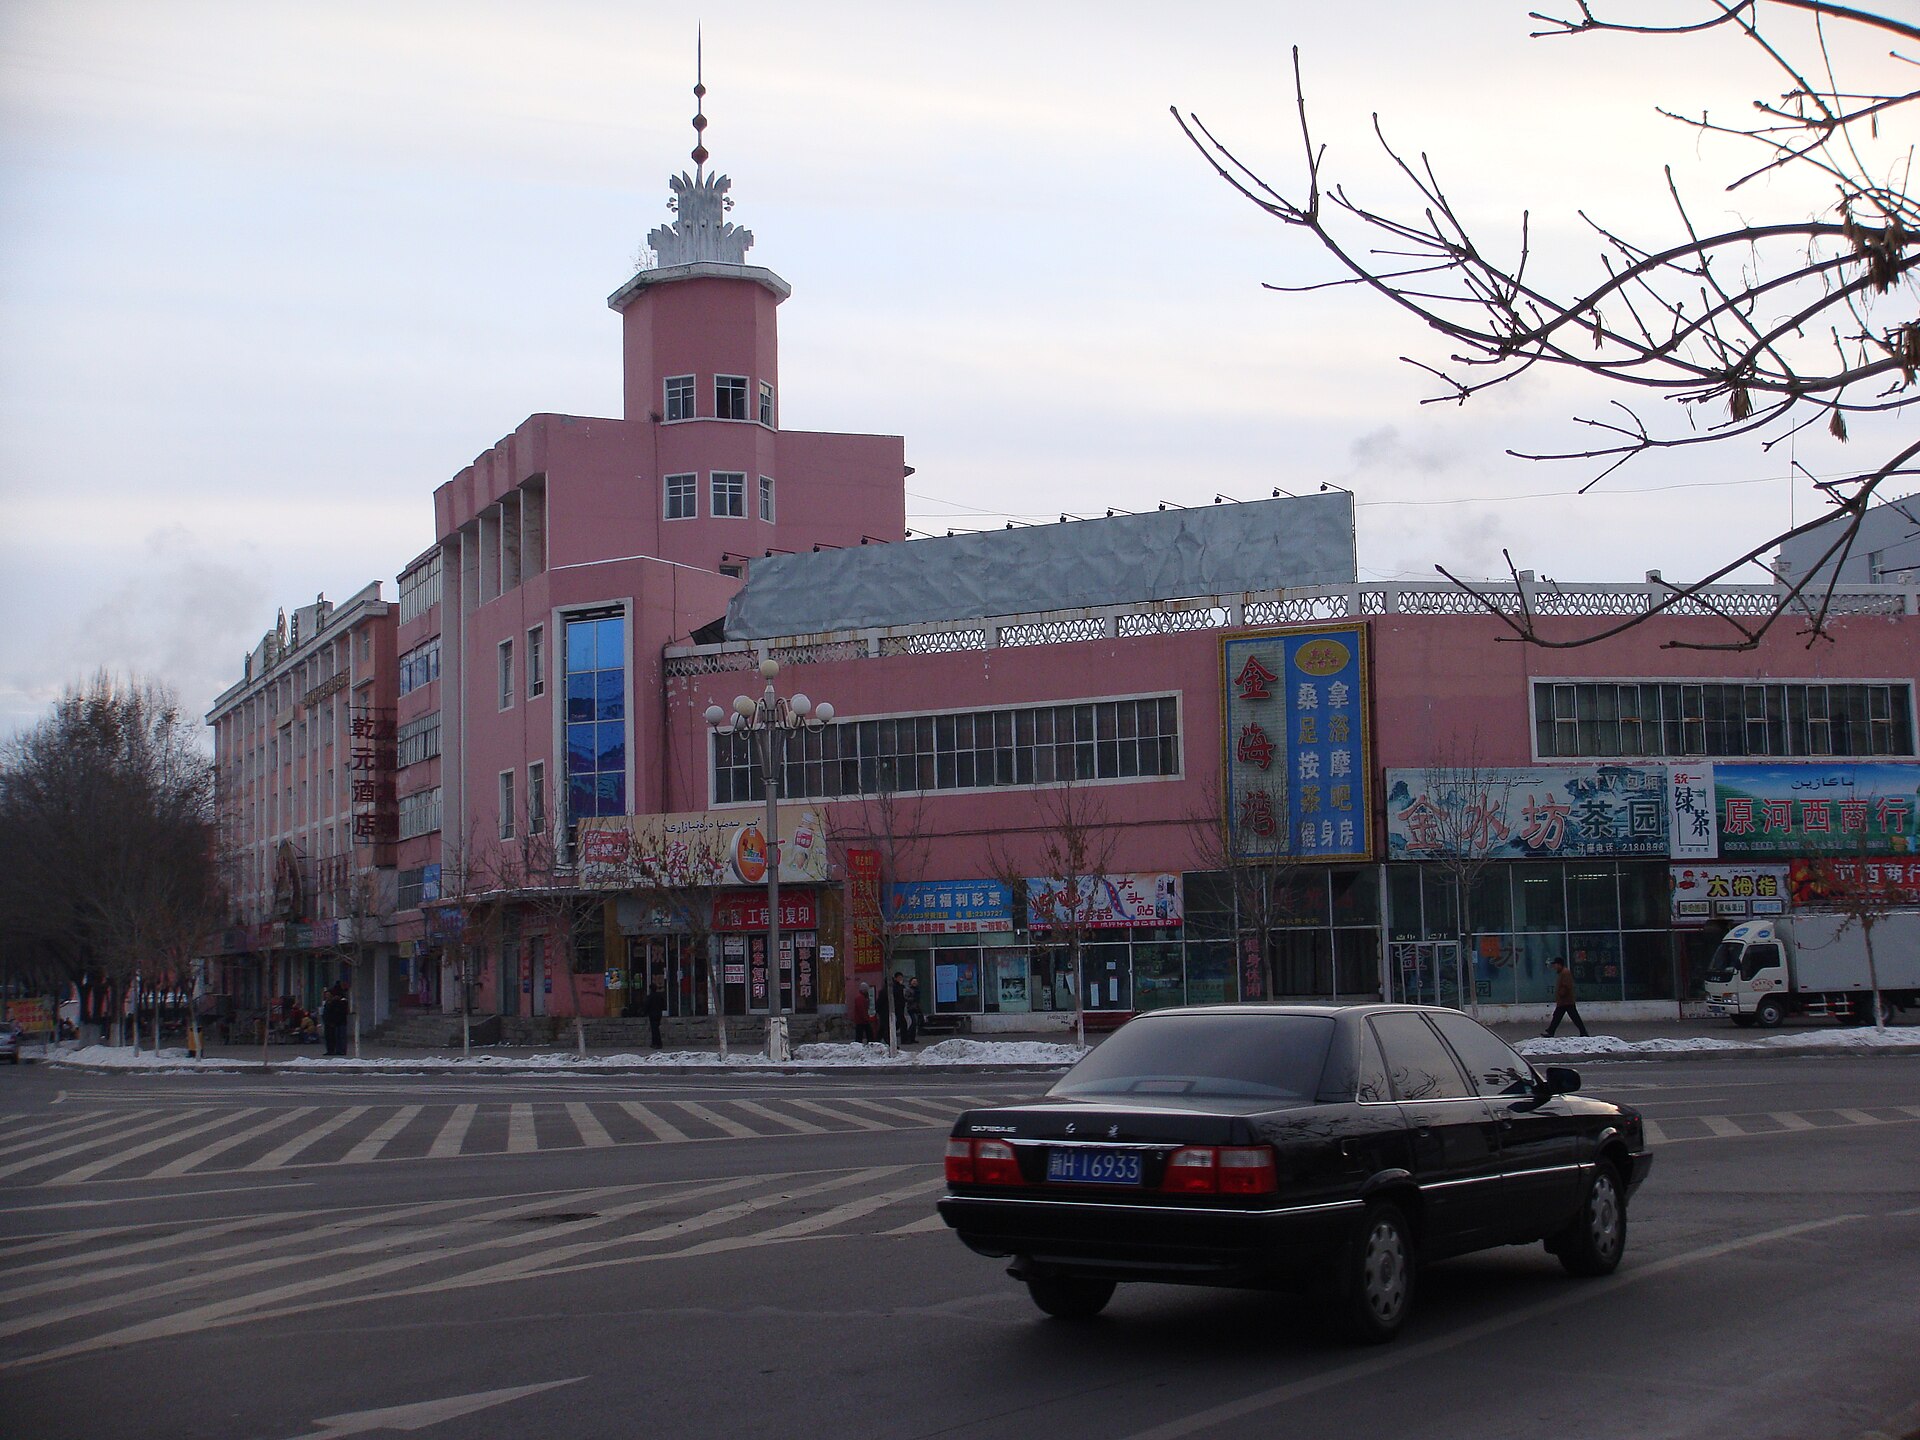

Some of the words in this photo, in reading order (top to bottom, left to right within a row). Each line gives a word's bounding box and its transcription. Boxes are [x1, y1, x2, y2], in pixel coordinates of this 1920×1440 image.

[1297, 680, 1350, 710] 桑拿
[1298, 715, 1352, 745] 足浴
[1233, 654, 1278, 838] 金海湾
[352, 715, 375, 837] 乾元酒店
[1298, 749, 1353, 780] 按摩
[1674, 773, 1701, 785] 统一
[1577, 774, 1619, 790] KTV
[1300, 784, 1353, 814] 茶吧
[1675, 787, 1710, 837] 绿茶
[1397, 791, 1571, 852] 金水坊
[1578, 797, 1663, 839] 茶园
[1724, 796, 1909, 834] 原河西商行
[1302, 818, 1354, 849] 健身房
[907, 891, 1002, 909] 中国福利彩票
[1117, 878, 1154, 917] 大头贴
[1707, 875, 1778, 897] 大拇指
